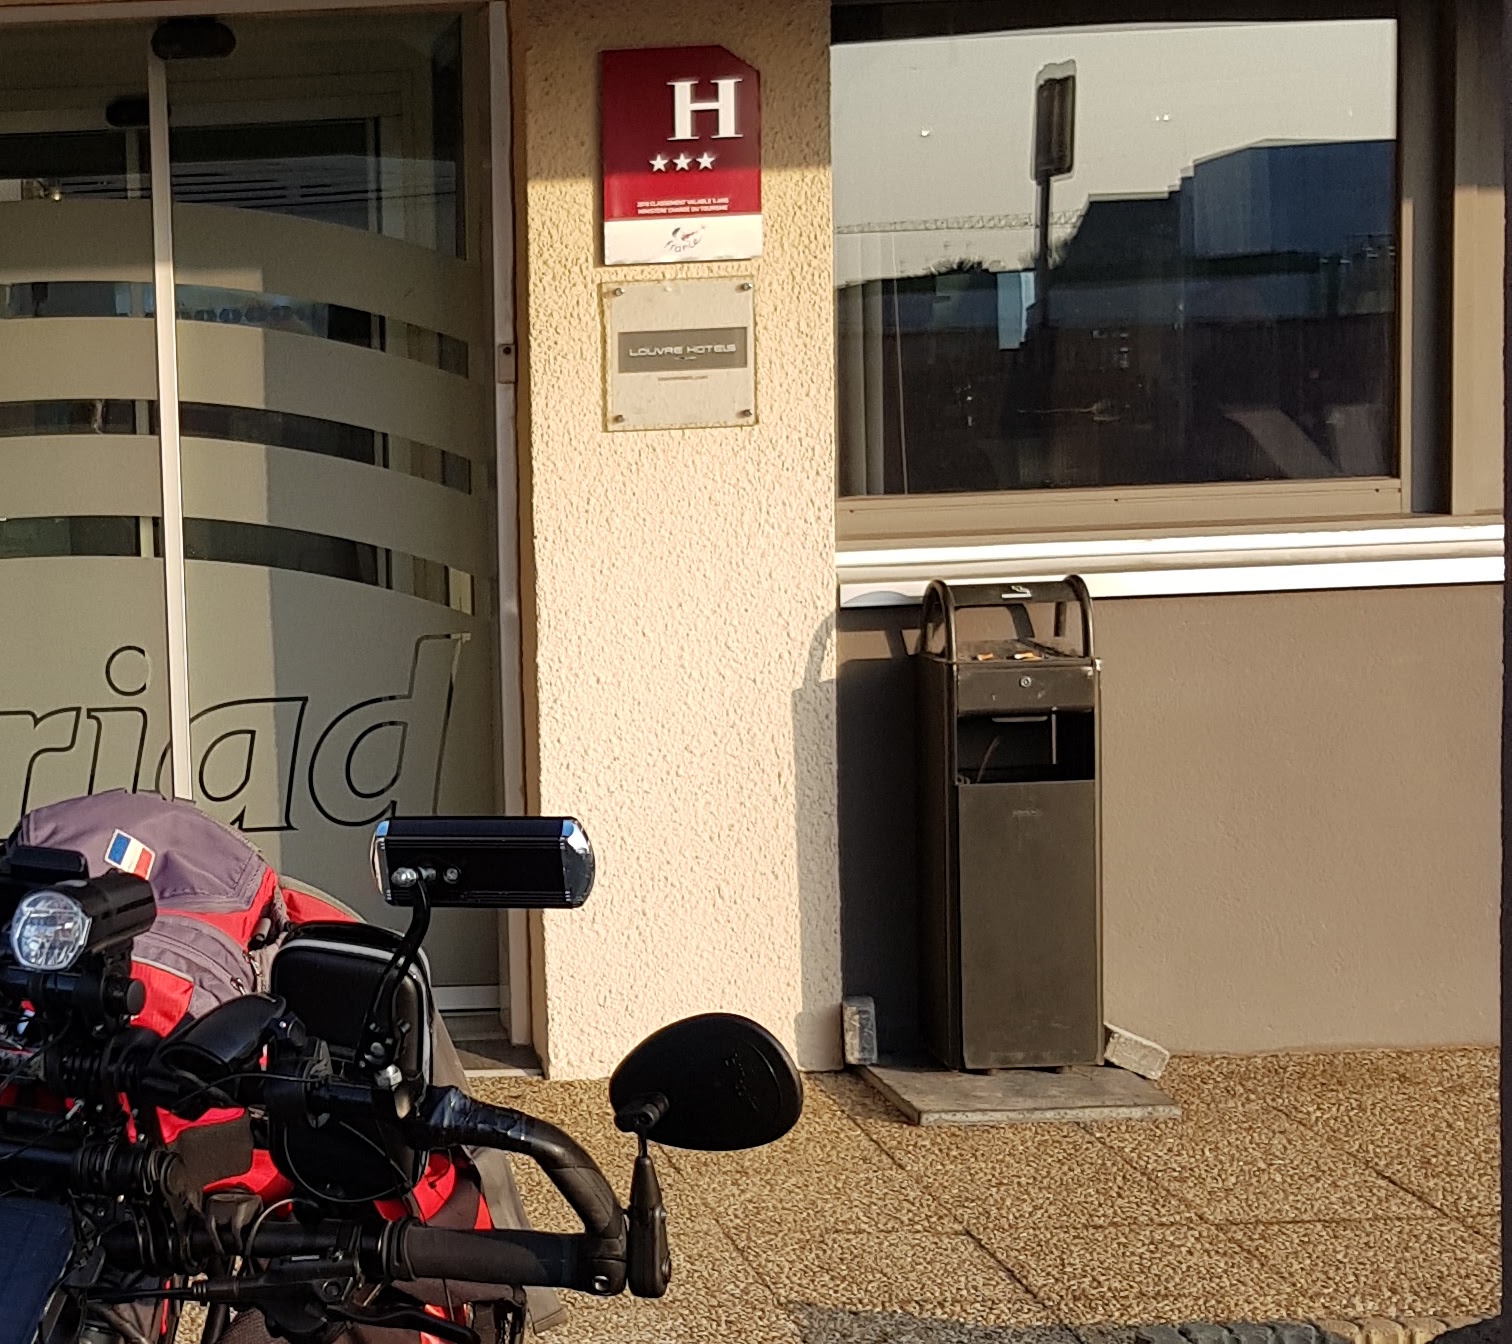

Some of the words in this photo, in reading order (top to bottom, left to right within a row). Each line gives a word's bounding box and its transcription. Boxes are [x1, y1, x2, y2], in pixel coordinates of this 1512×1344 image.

[666, 78, 744, 141] H
[629, 346, 683, 357] LOUVRE
[686, 343, 737, 355] HOTELS
